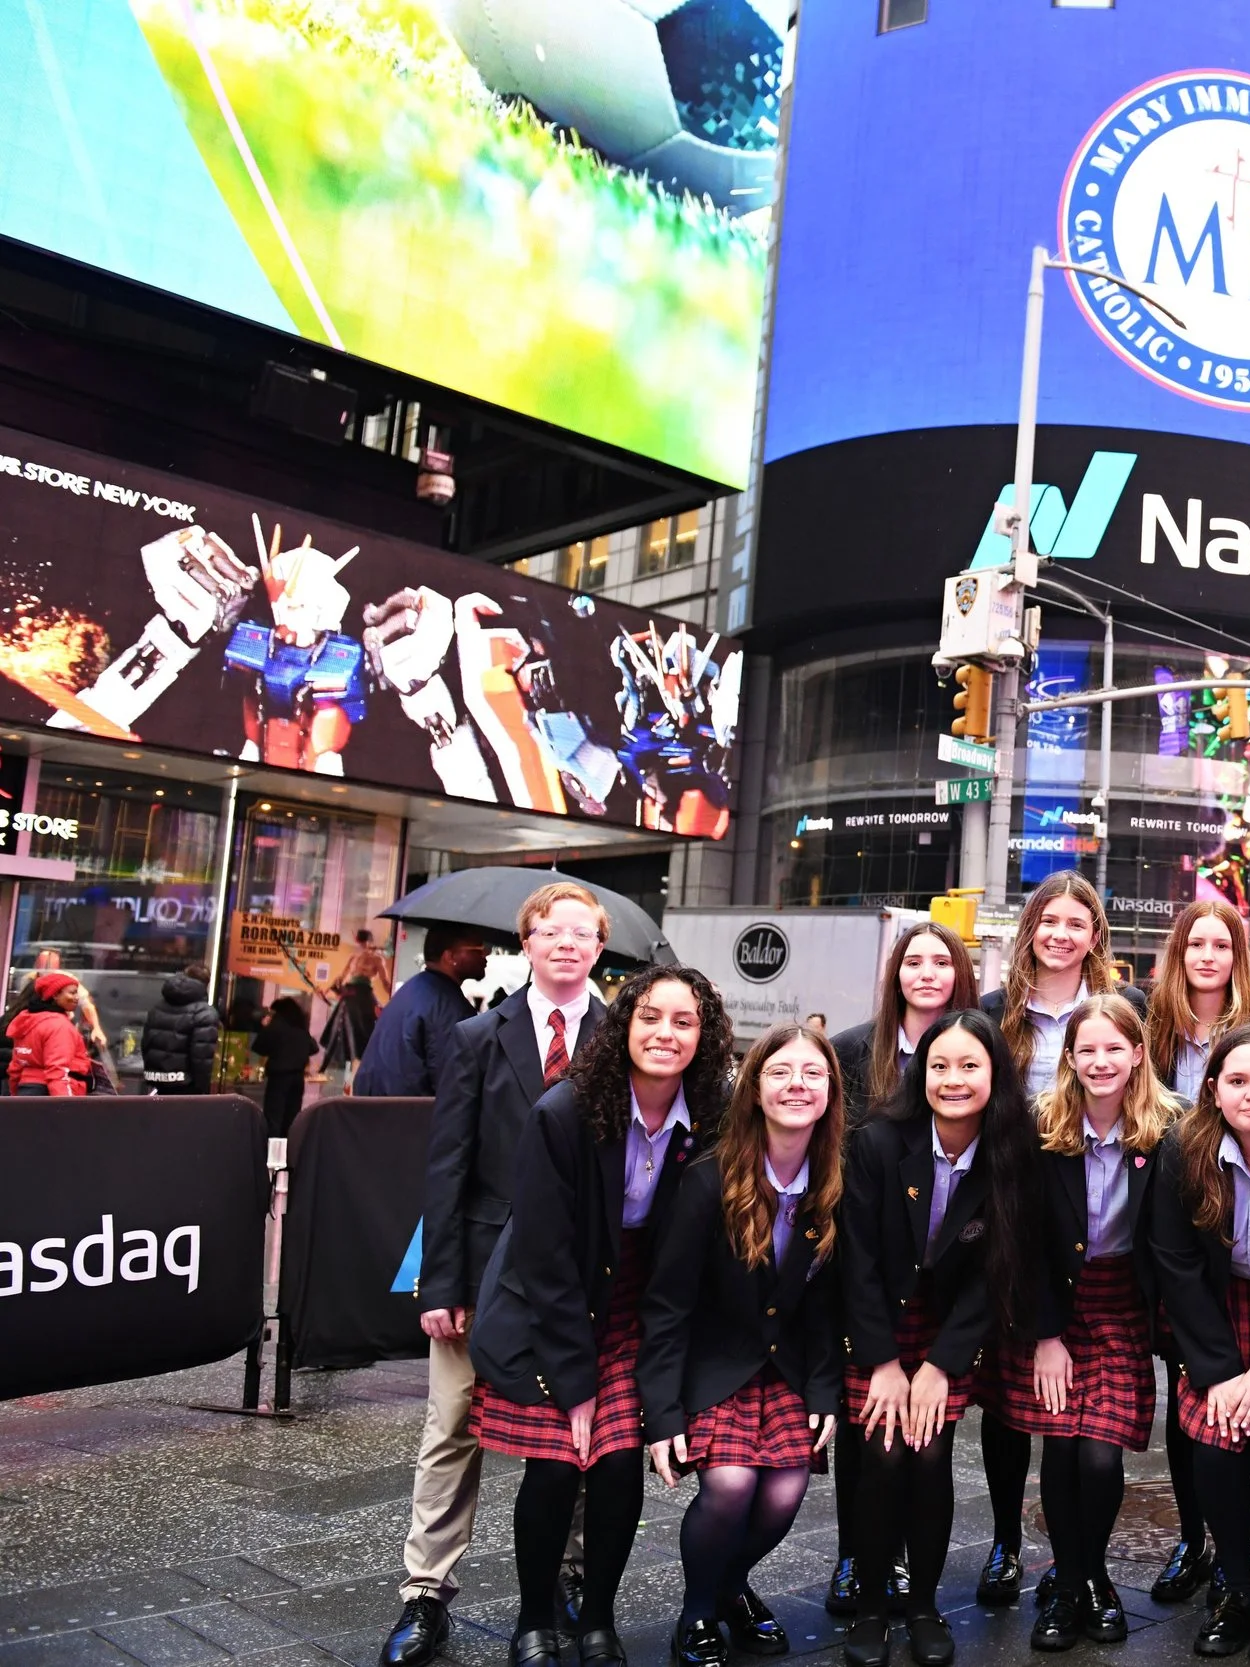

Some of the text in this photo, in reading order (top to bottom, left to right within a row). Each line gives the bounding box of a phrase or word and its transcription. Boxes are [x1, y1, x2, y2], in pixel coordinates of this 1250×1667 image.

[1089, 94, 1174, 176] MARY
[1075, 210, 1174, 363] CATHOLIC
[24, 462, 91, 495] STORE
[93, 481, 140, 507] NEW
[141, 493, 196, 523] YORK
[951, 741, 993, 772] Broadway
[949, 783, 961, 801] W
[966, 781, 979, 799] 43
[12, 812, 78, 840] STORE
[846, 814, 885, 826] REWRITE
[888, 812, 949, 824] TOMORROW
[1130, 817, 1181, 831] REWRITE
[1113, 897, 1173, 917] Nasdaq
[307, 931, 341, 947] ZORO
[740, 931, 784, 965] Baldor
[739, 995, 775, 1017] Specialty
[778, 996, 800, 1014] Foods
